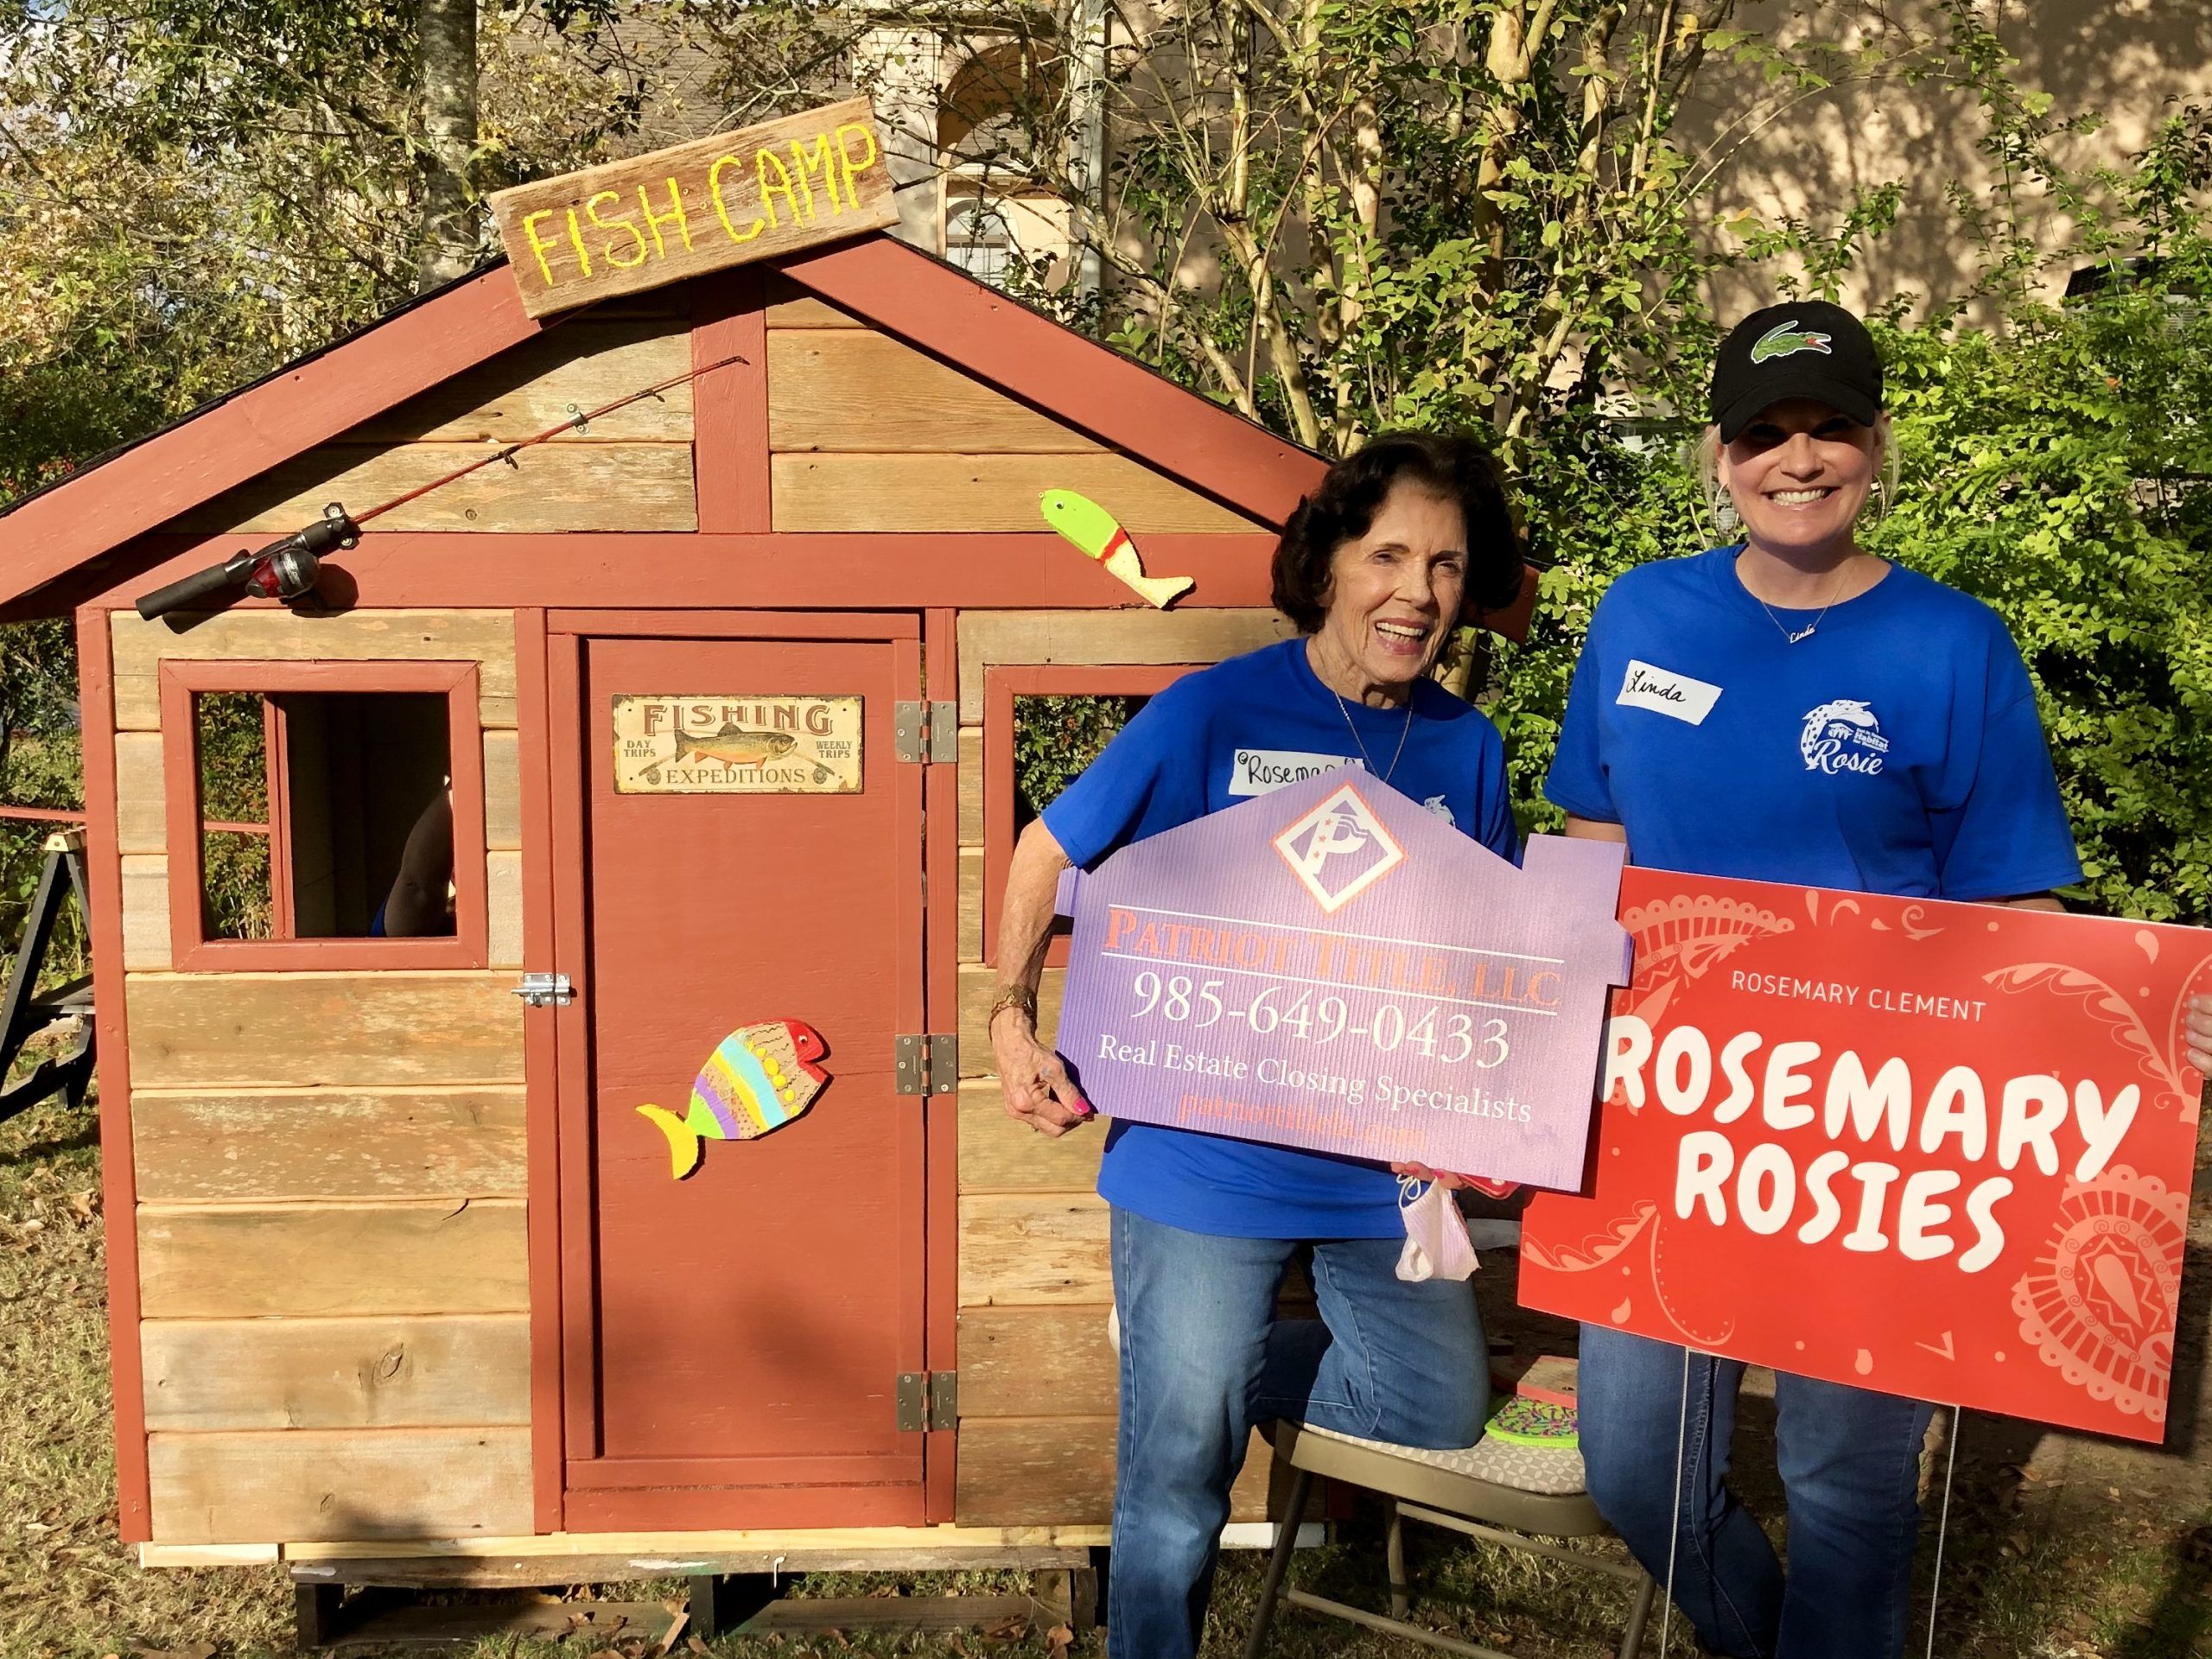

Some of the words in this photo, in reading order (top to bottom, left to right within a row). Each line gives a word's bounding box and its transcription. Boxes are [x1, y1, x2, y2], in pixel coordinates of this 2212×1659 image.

[522, 176, 694, 286] FISH
[709, 123, 878, 245] CAMP
[1625, 670, 1688, 703] Linda
[643, 704, 833, 736] FISHING
[623, 748, 657, 758] TRIPS
[626, 740, 652, 749] DAY
[816, 741, 853, 750] WEEKLY
[818, 750, 851, 759] TRIPS
[1809, 738, 1884, 775] Rosie
[666, 768, 806, 785] EXPEDITIONS
[1104, 908, 1296, 971] PATRIOT
[1473, 962, 1562, 1007] LLC
[1731, 969, 1860, 1006] ROSEMARY
[1868, 988, 1987, 1022] CLEMENT
[1130, 971, 1510, 1069] 985-649-0433
[1097, 1033, 1156, 1066] Real
[1163, 1043, 1249, 1080] Estate
[1256, 1058, 1367, 1105] Closing
[1375, 1075, 1533, 1123] Specialists
[1602, 1014, 2141, 1184] ROSEMARY
[1674, 1130, 2014, 1274] ROSIES
